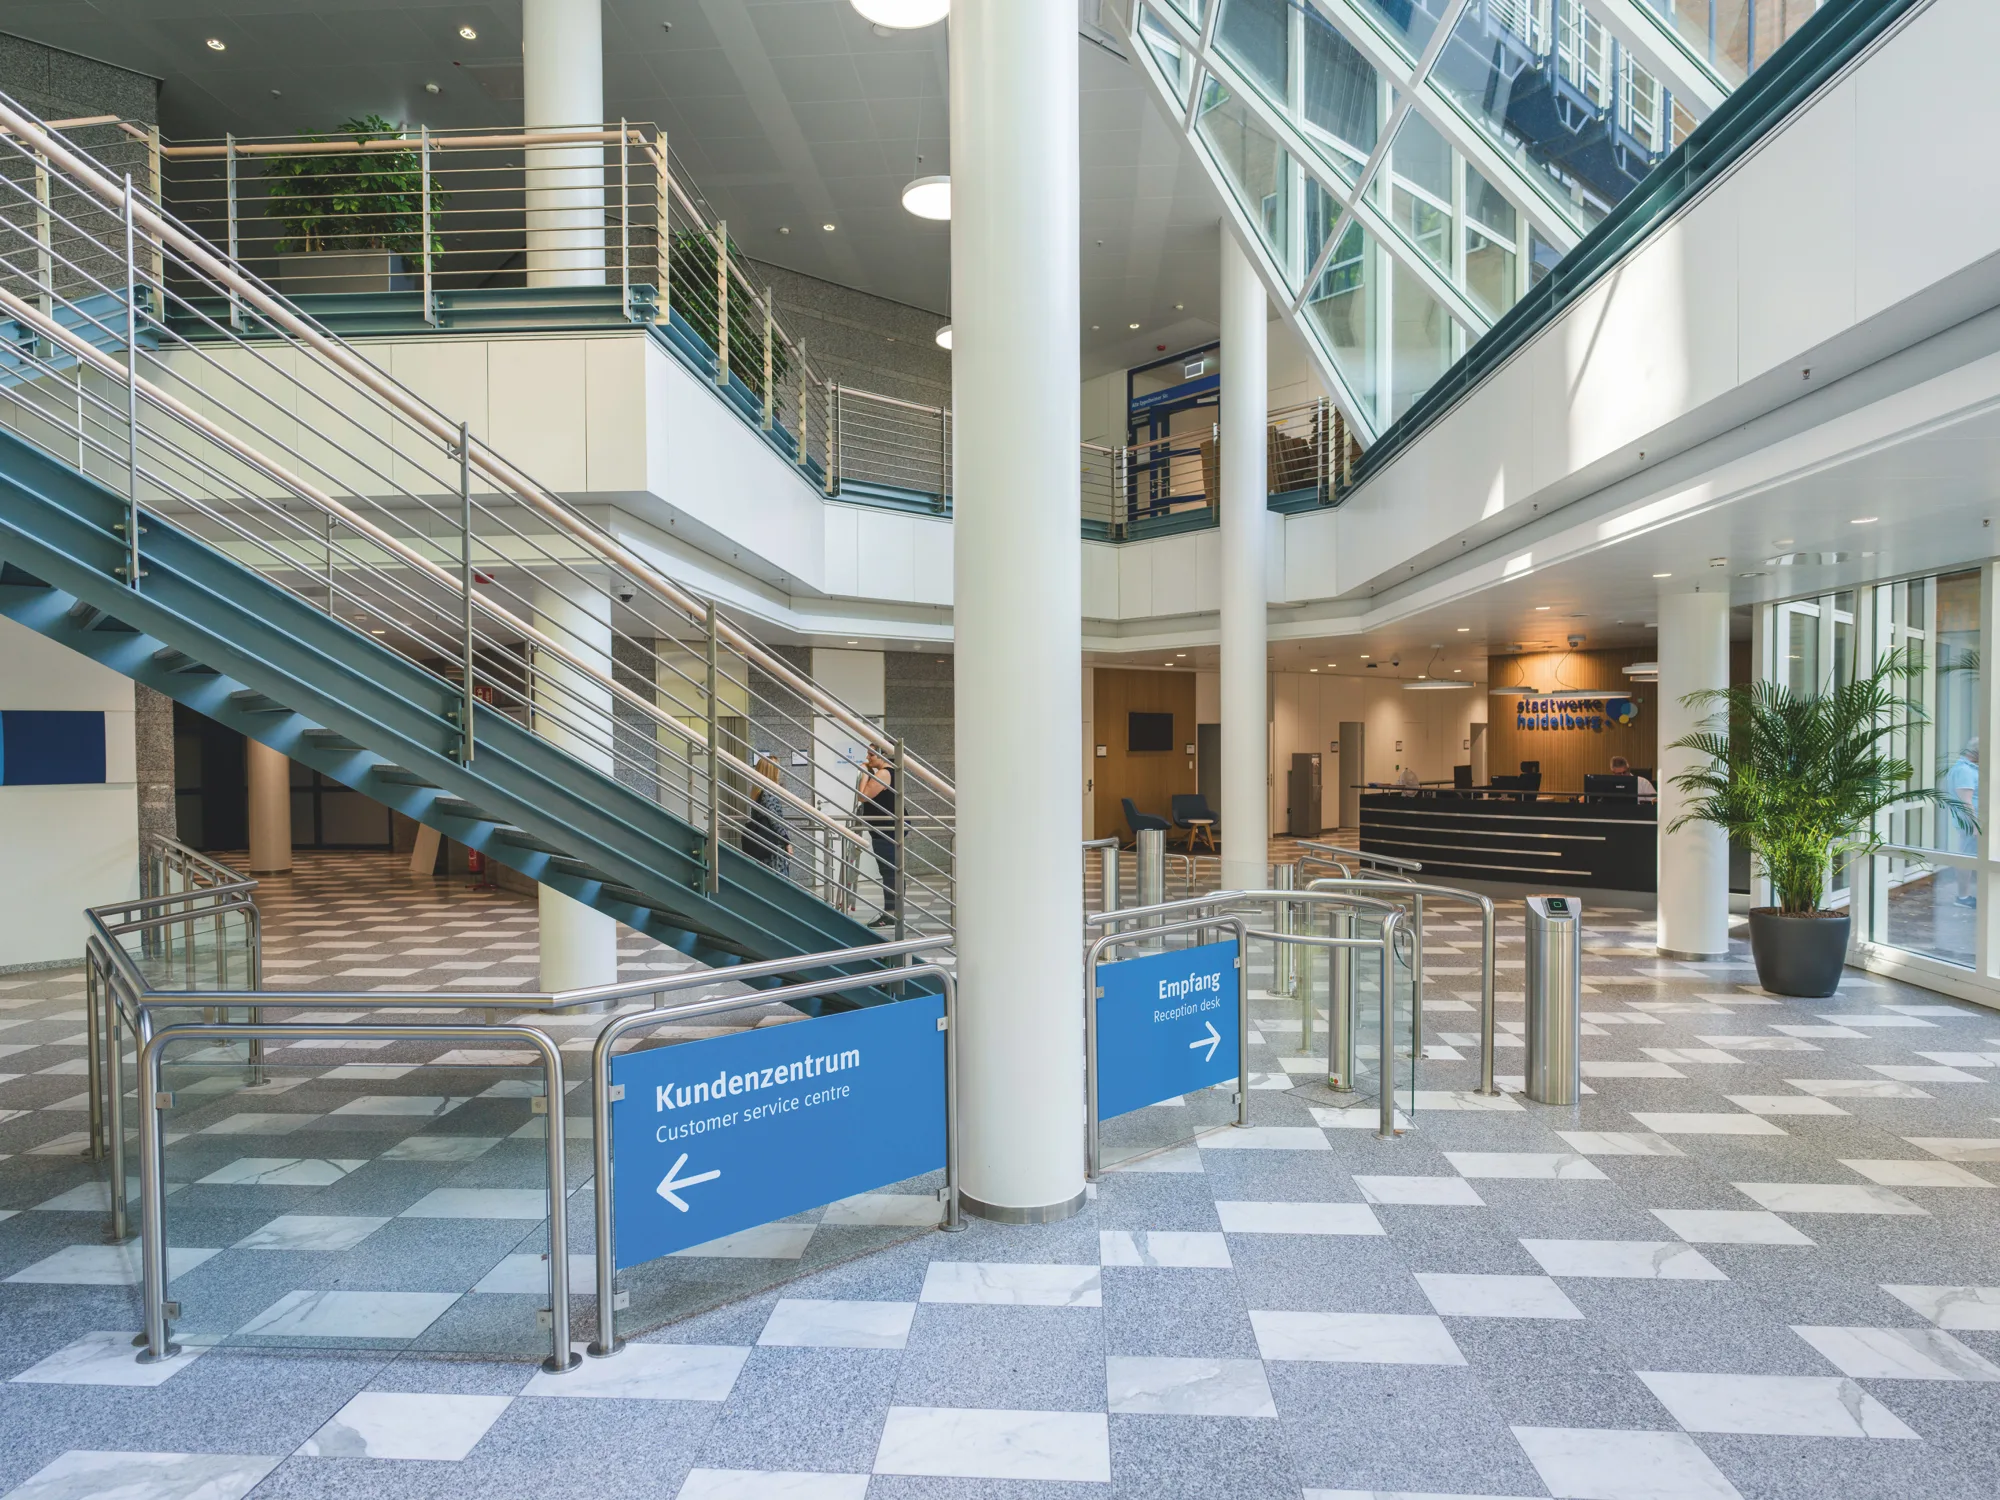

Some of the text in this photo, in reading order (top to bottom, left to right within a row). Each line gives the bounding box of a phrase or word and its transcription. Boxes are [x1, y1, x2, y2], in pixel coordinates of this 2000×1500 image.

[1517, 699, 1602, 712] stadtwerke
[1159, 972, 1221, 1000] Empfang
[1154, 996, 1221, 1023] Reception desk
[656, 1048, 860, 1113] Kundenzentrum
[656, 1084, 850, 1144] Customer service centre
